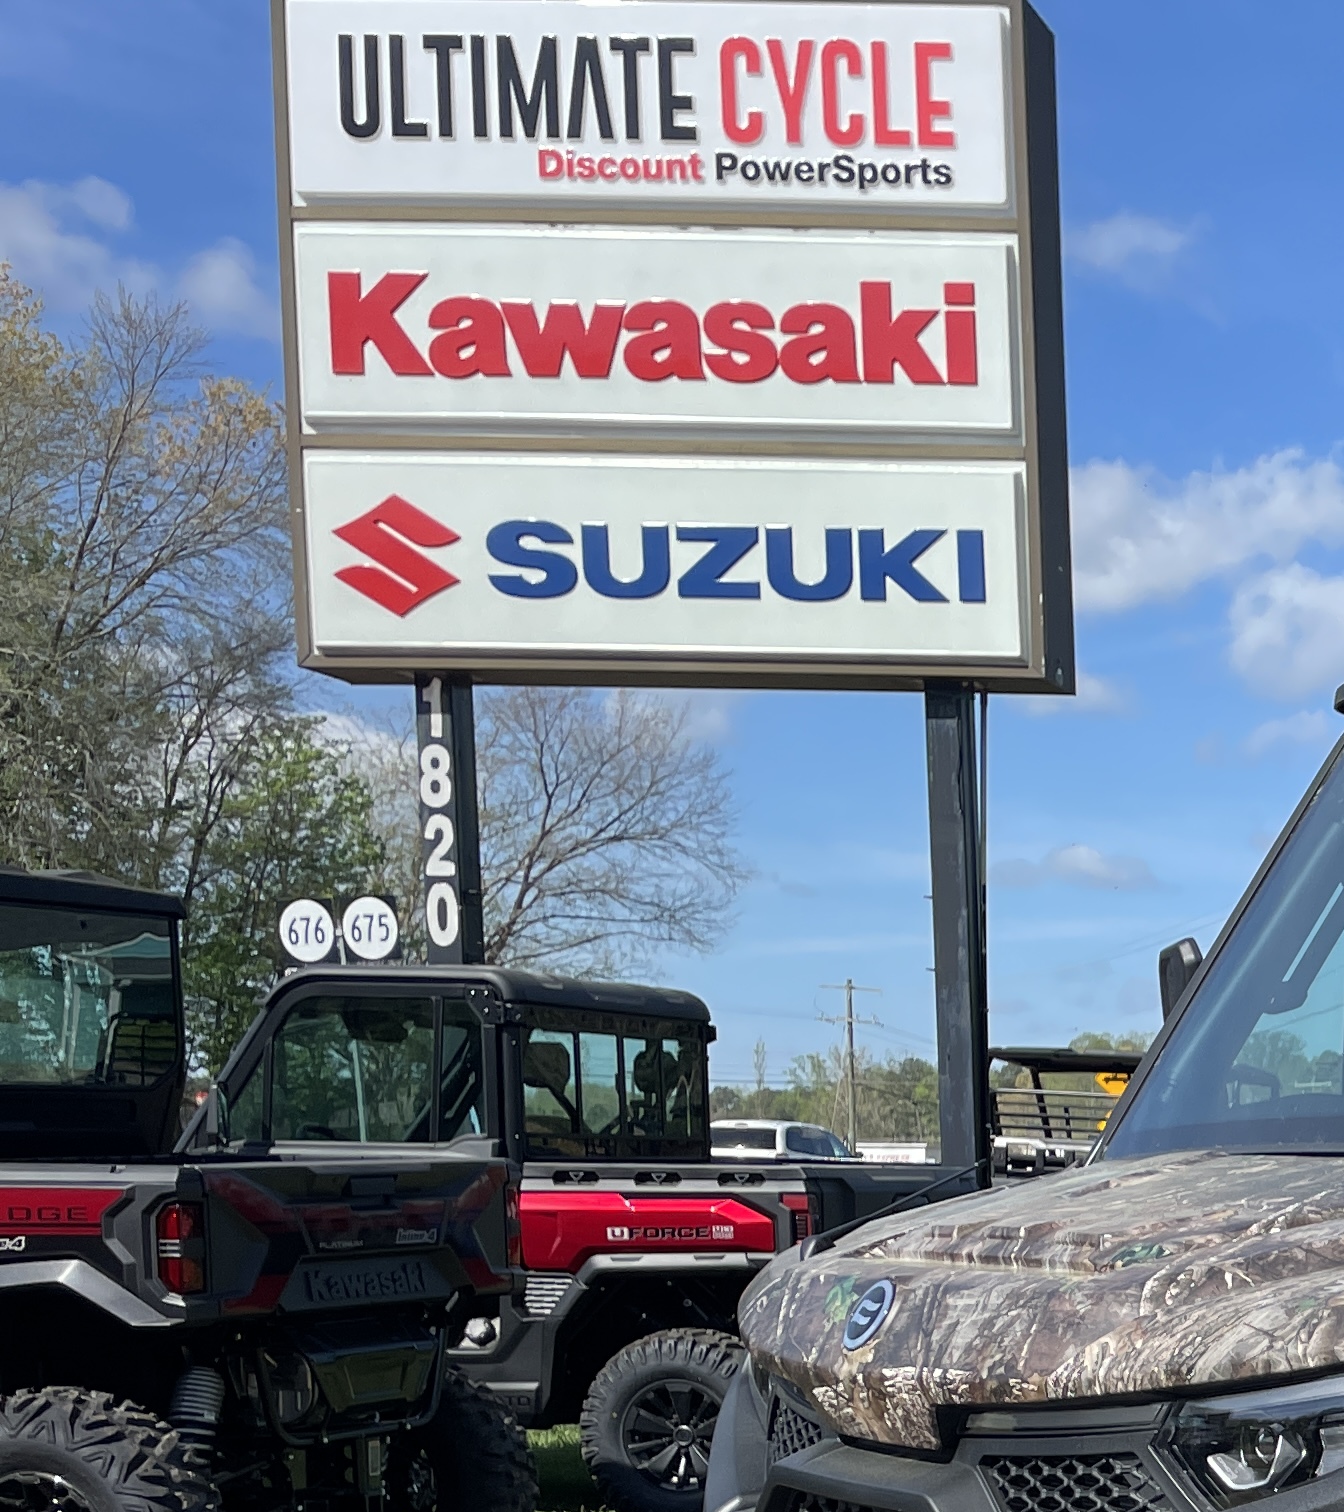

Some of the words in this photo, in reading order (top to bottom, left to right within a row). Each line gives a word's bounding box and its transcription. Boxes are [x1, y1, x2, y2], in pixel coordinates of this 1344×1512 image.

[337, 34, 697, 142] ULTIMATE
[719, 38, 957, 149] CYCLE
[537, 148, 702, 183] Discount
[715, 151, 953, 189] PowerSports
[327, 270, 978, 386] Kawasaki
[486, 518, 986, 604] SUZUKI
[288, 916, 325, 945] 676
[351, 914, 390, 942] 675
